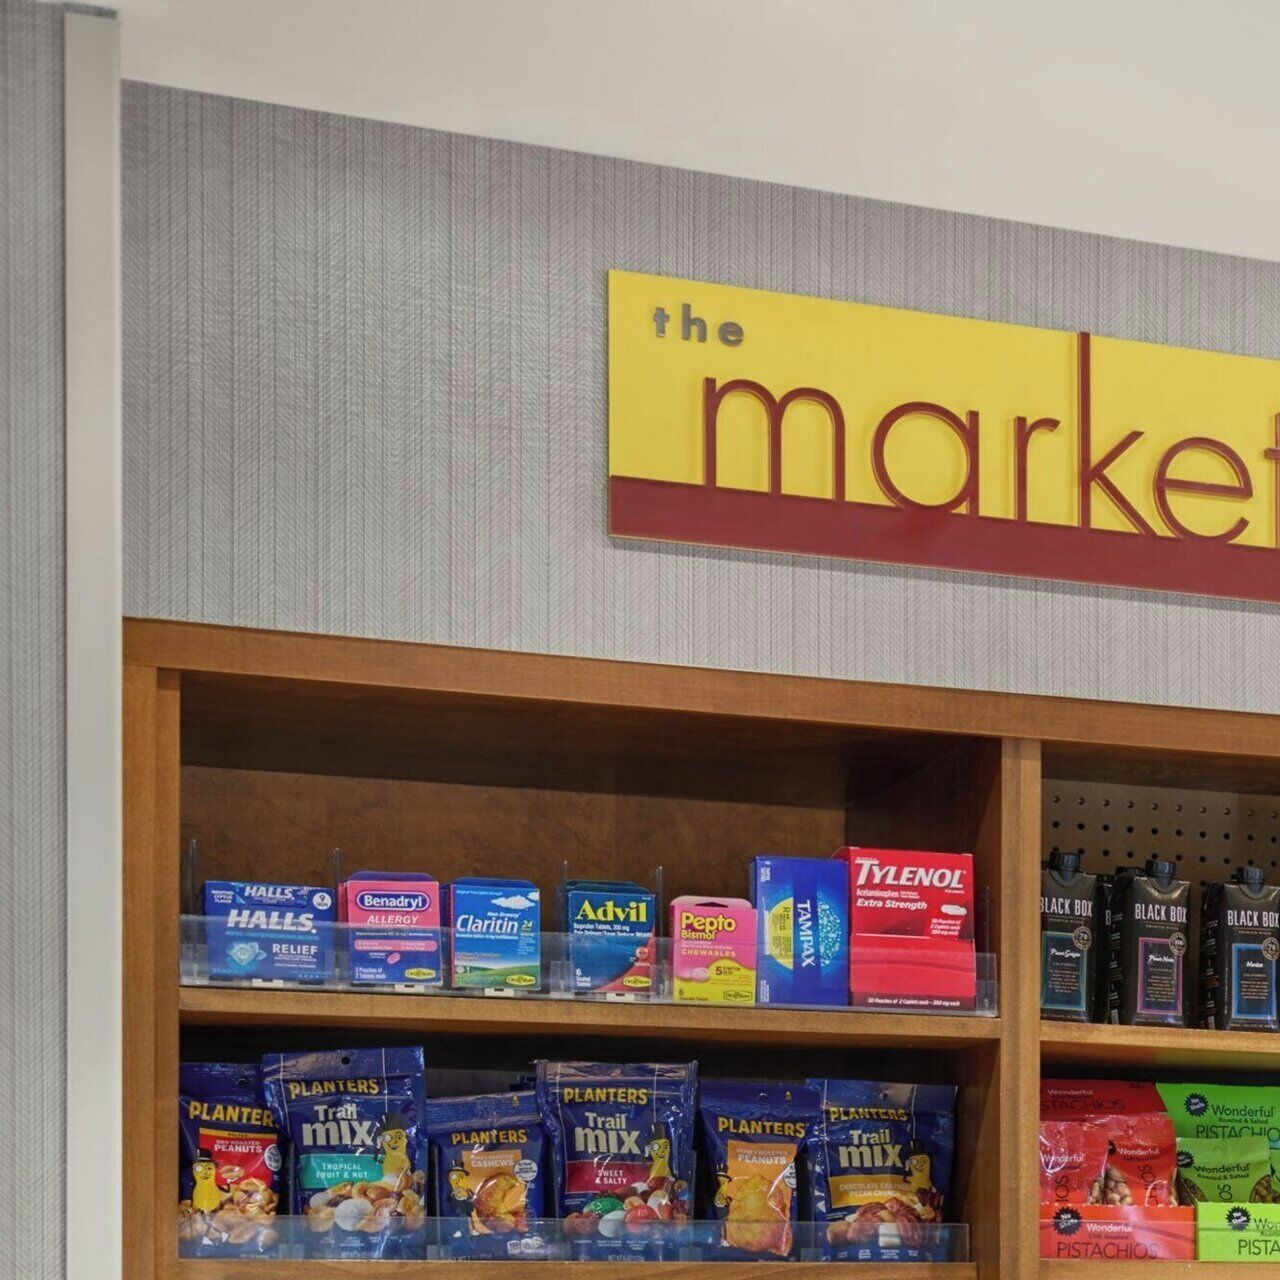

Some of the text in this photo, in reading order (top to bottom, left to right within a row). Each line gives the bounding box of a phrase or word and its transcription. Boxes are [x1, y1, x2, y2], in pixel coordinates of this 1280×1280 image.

[654, 304, 745, 347] the
[855, 860, 963, 889] TYLENOL
[364, 895, 422, 910] Benadryl
[575, 899, 647, 922] Advil
[856, 899, 927, 911] Extra Strength
[1075, 899, 1093, 917] BOX
[367, 915, 419, 925] ALLERGY
[679, 912, 735, 933] Pepto
[1135, 904, 1187, 923] BLACK BOX
[1228, 910, 1279, 928] BLACK BOX
[456, 914, 518, 933] Claritin
[679, 929, 714, 940] Bismol
[797, 899, 815, 968] TAMPAX
[273, 944, 318, 955] RELIEF
[680, 948, 736, 958] CHEWABLES
[289, 1078, 379, 1099] PLANTERS
[564, 1087, 648, 1105] PLANTERS
[314, 1103, 357, 1121] Trail
[584, 1112, 626, 1129] Trail
[830, 1107, 907, 1122] PLANTERS
[1212, 1106, 1275, 1117] Wonderful
[302, 1120, 376, 1146] mix
[718, 1116, 806, 1137] PLANTERS
[451, 1130, 527, 1145] PLANTERS
[575, 1126, 641, 1154] mix
[850, 1129, 890, 1146] Trail
[214, 1143, 263, 1154] PEANUTS
[839, 1144, 903, 1168] mix
[1194, 1163, 1250, 1175] Wonderful
[1086, 1223, 1132, 1232] Wonderful
[1057, 1242, 1157, 1259] PISTACHIOS
